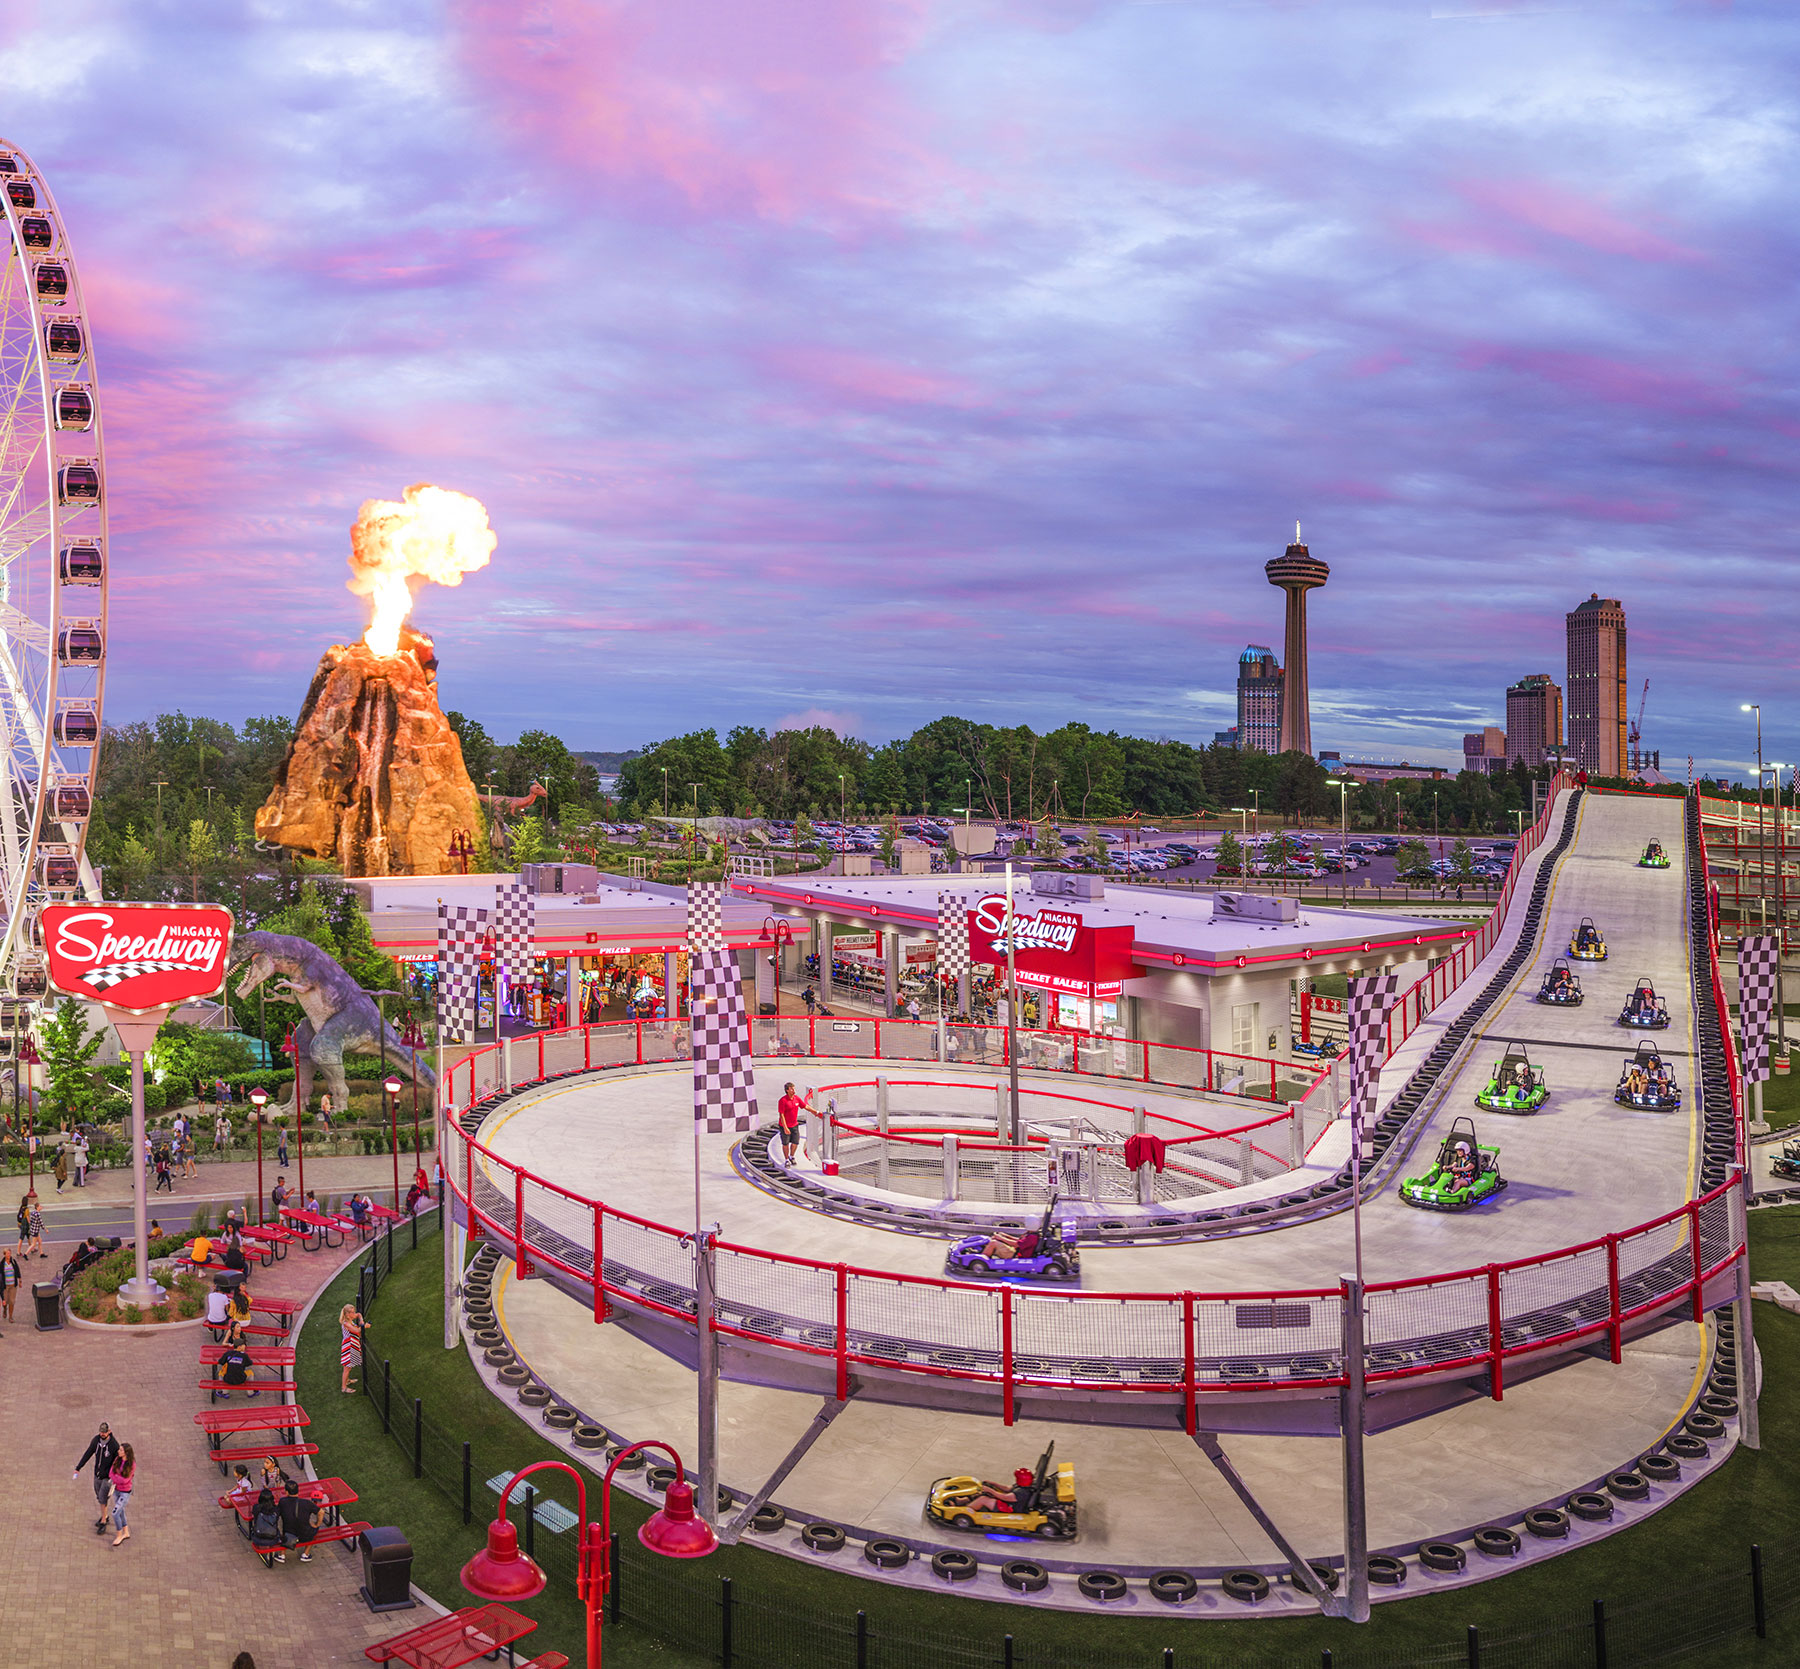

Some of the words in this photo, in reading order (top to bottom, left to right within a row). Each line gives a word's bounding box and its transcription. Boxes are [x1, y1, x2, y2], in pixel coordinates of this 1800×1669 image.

[975, 897, 1077, 952] Speedway
[1043, 912, 1078, 926] NIAGARA
[169, 925, 222, 938] NIAGARA
[55, 912, 222, 973] Speedway
[398, 953, 434, 962] PRIZES
[599, 946, 631, 955] PRIZES
[1019, 970, 1051, 984] TICKET
[1053, 975, 1084, 990] SALES
